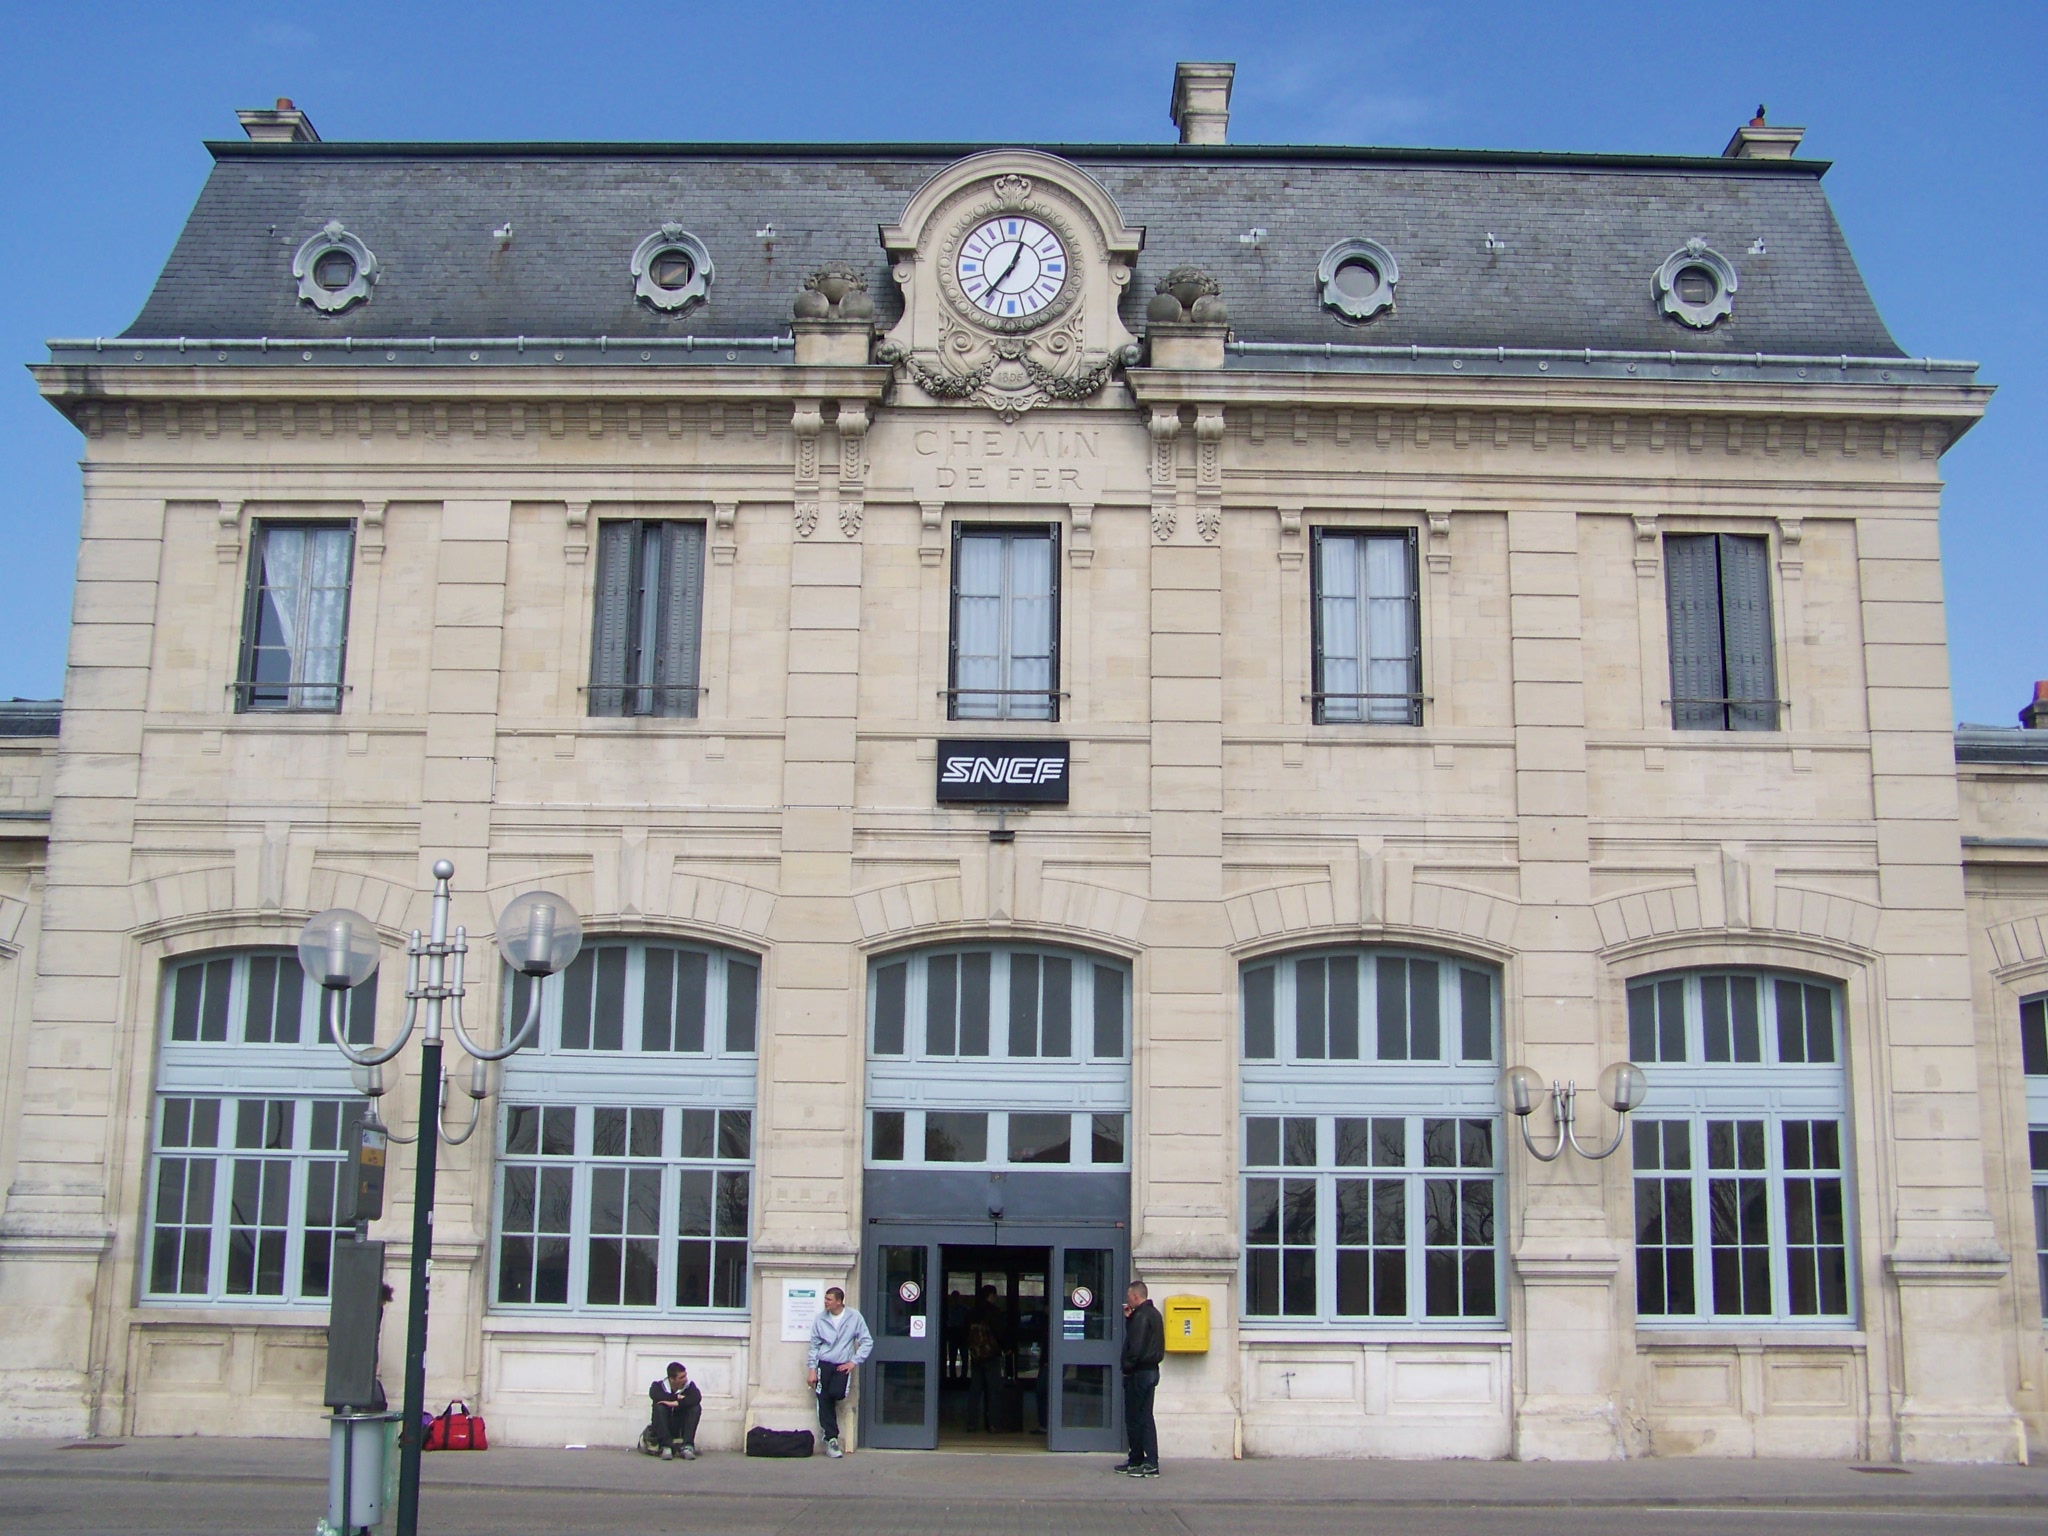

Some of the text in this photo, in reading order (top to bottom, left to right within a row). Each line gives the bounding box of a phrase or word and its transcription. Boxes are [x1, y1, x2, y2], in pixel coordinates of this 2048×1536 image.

[913, 430, 1100, 458] CHEMIN
[936, 467, 1084, 490] DE FER
[941, 757, 1065, 784] SNCF
